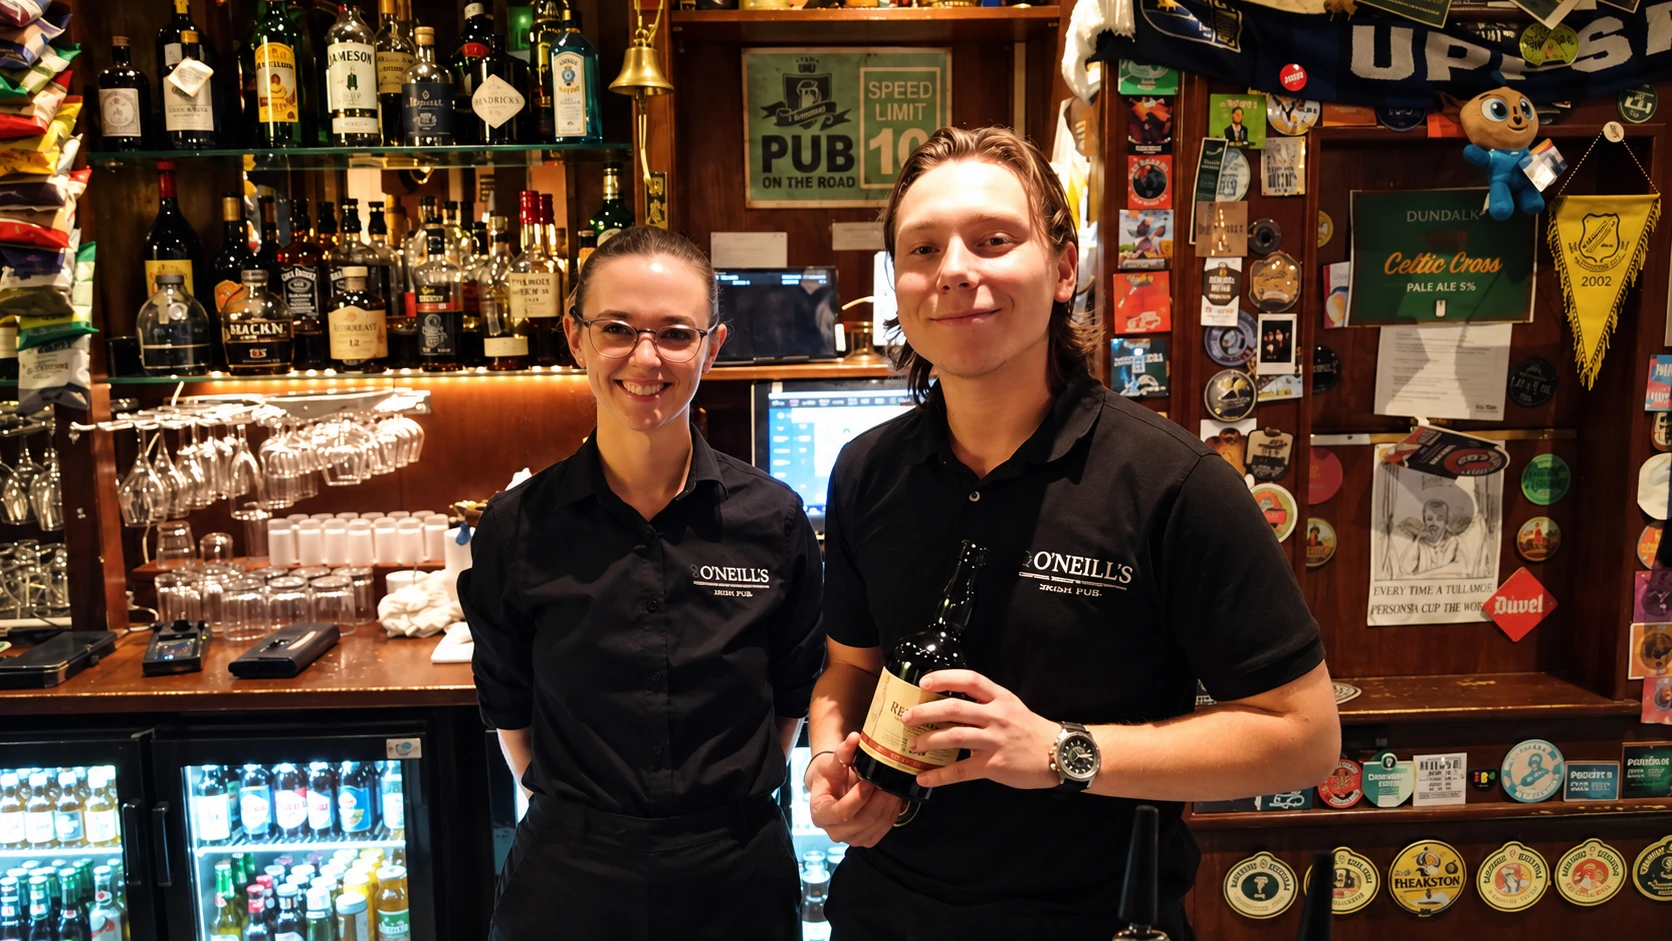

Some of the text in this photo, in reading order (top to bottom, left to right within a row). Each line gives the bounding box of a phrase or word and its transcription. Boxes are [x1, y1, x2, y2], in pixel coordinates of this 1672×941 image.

[329, 50, 372, 68] JAMESON
[868, 81, 933, 99] SPEED
[875, 103, 927, 121] LIMIT
[761, 134, 855, 173] PUB
[762, 176, 856, 189] ON THE ROAD
[1406, 209, 1480, 222] DUNDALK
[1384, 251, 1503, 275] Celtic Cross
[1406, 281, 1477, 292] PALE ALE 5%
[1580, 276, 1612, 287] 2002
[349, 339, 360, 347] 12
[699, 565, 770, 583] O'NEILL'S
[1033, 550, 1133, 584] O'NEILL'S
[1373, 585, 1406, 596] EVERY
[1408, 585, 1434, 596] TIME
[1436, 585, 1443, 595] A
[1421, 602, 1441, 614] CUP
[1443, 602, 1461, 613] THE
